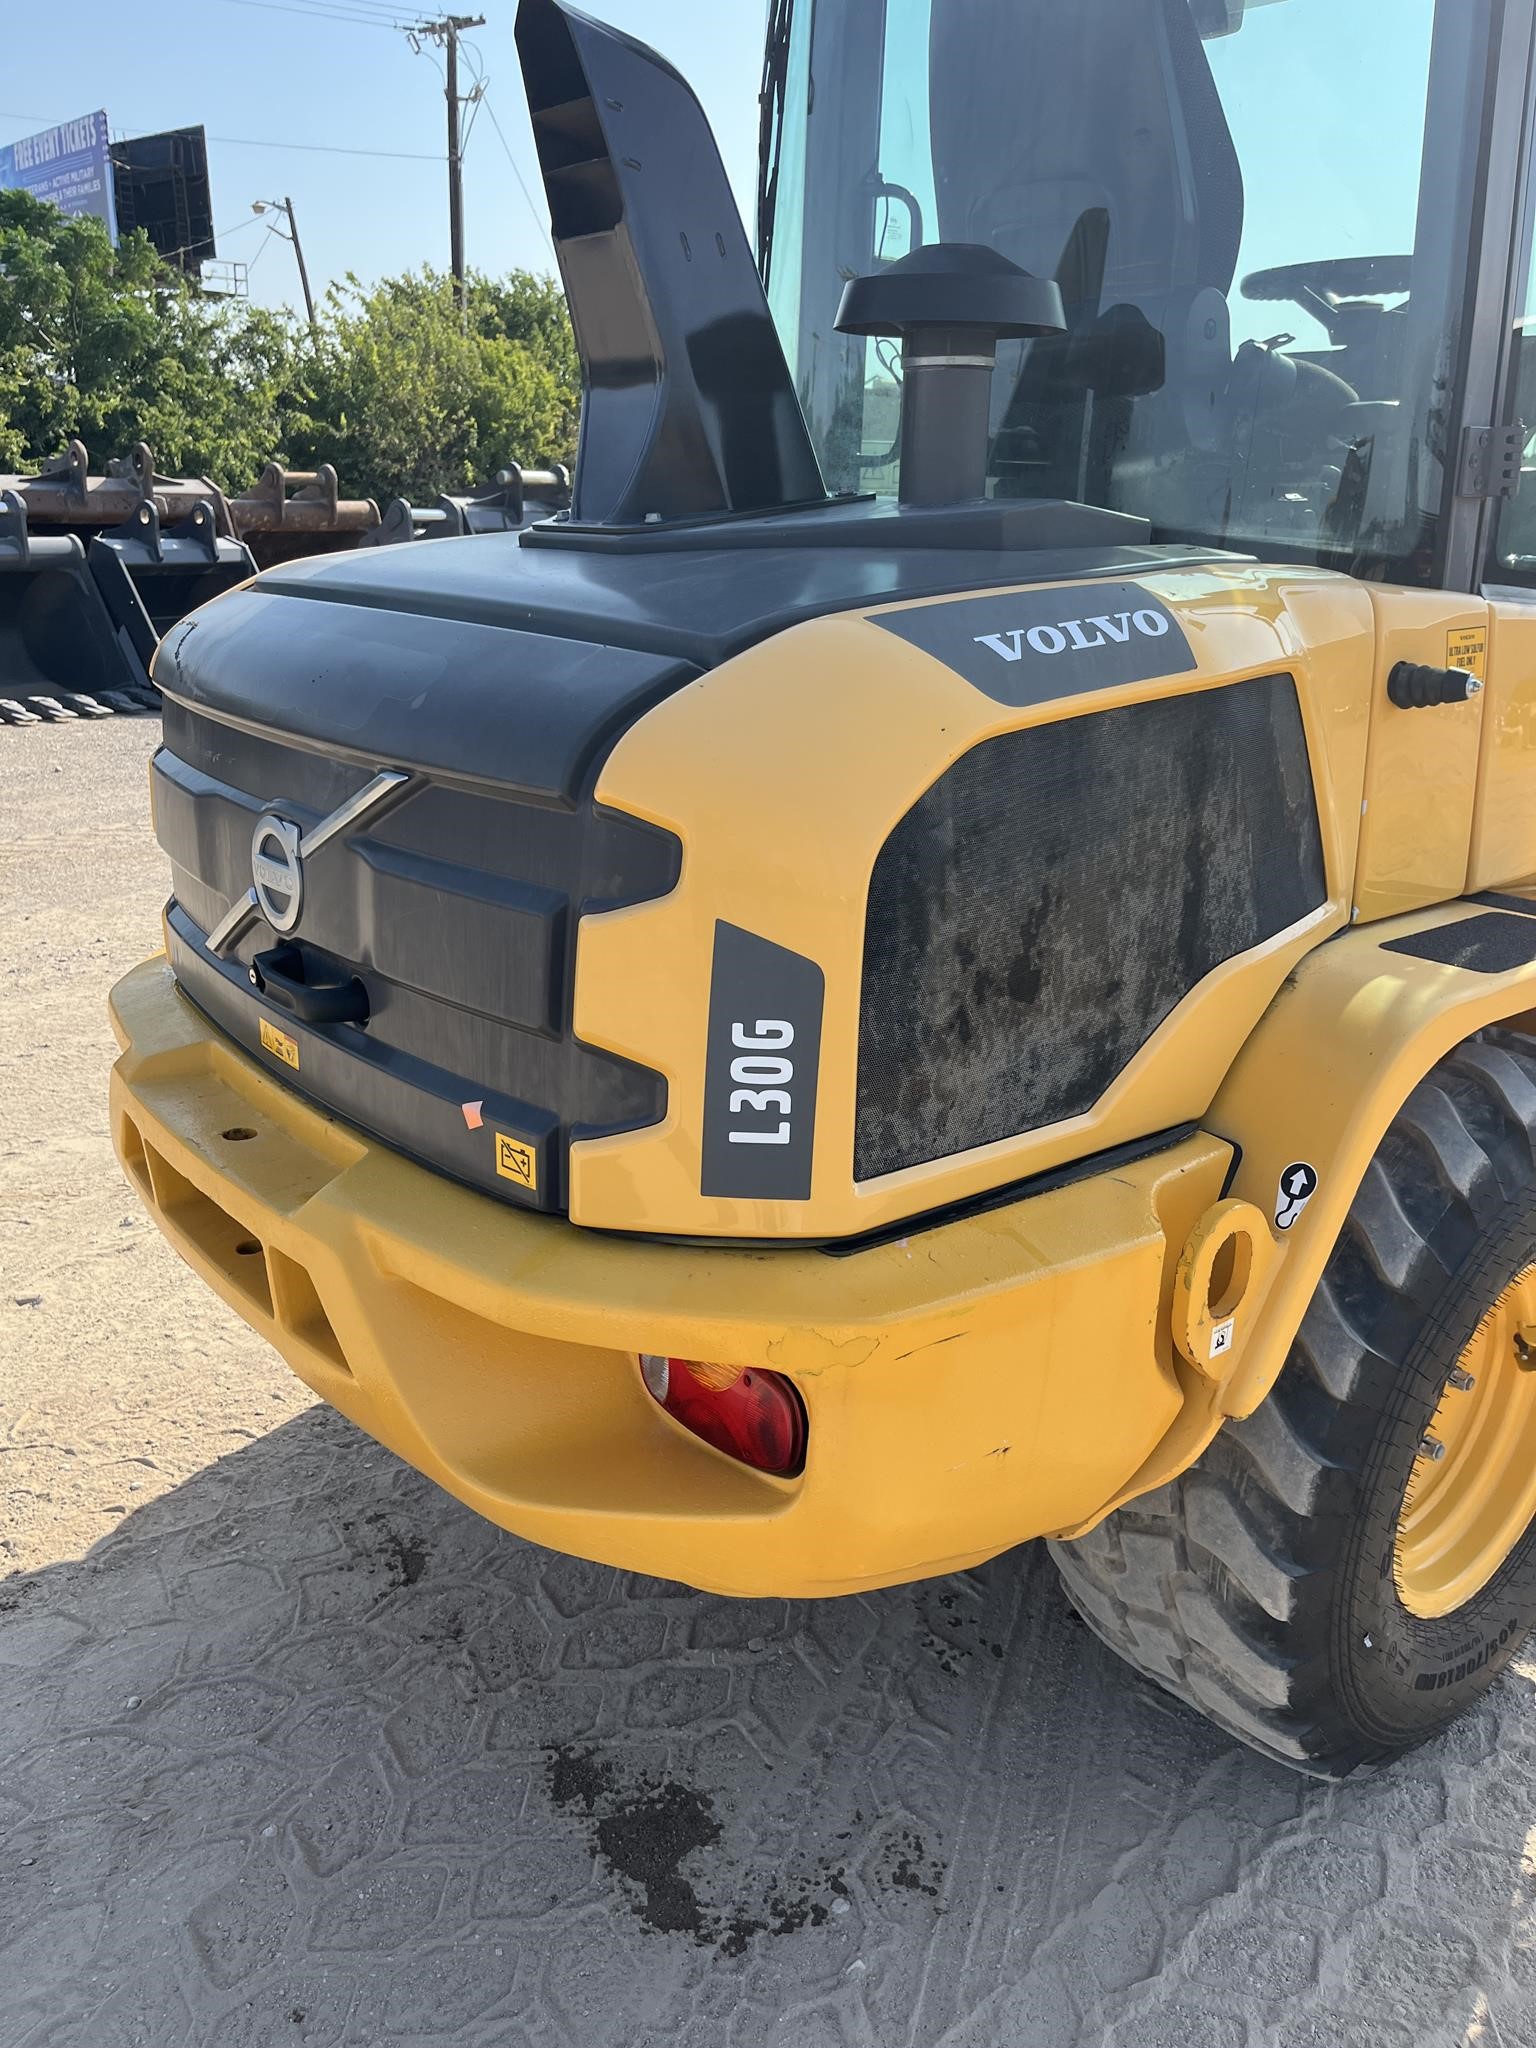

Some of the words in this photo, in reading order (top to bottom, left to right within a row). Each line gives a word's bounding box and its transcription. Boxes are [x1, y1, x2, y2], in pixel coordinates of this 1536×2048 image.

[14, 137, 34, 171] FREE
[33, 127, 60, 165] EVENT
[60, 114, 97, 154] TICKETS
[52, 172, 70, 188] ACTIVE
[70, 165, 95, 182] MILITARY
[973, 609, 1169, 662] VOLVO
[254, 864, 295, 890] VOLVO
[728, 1019, 795, 1145] L30G
